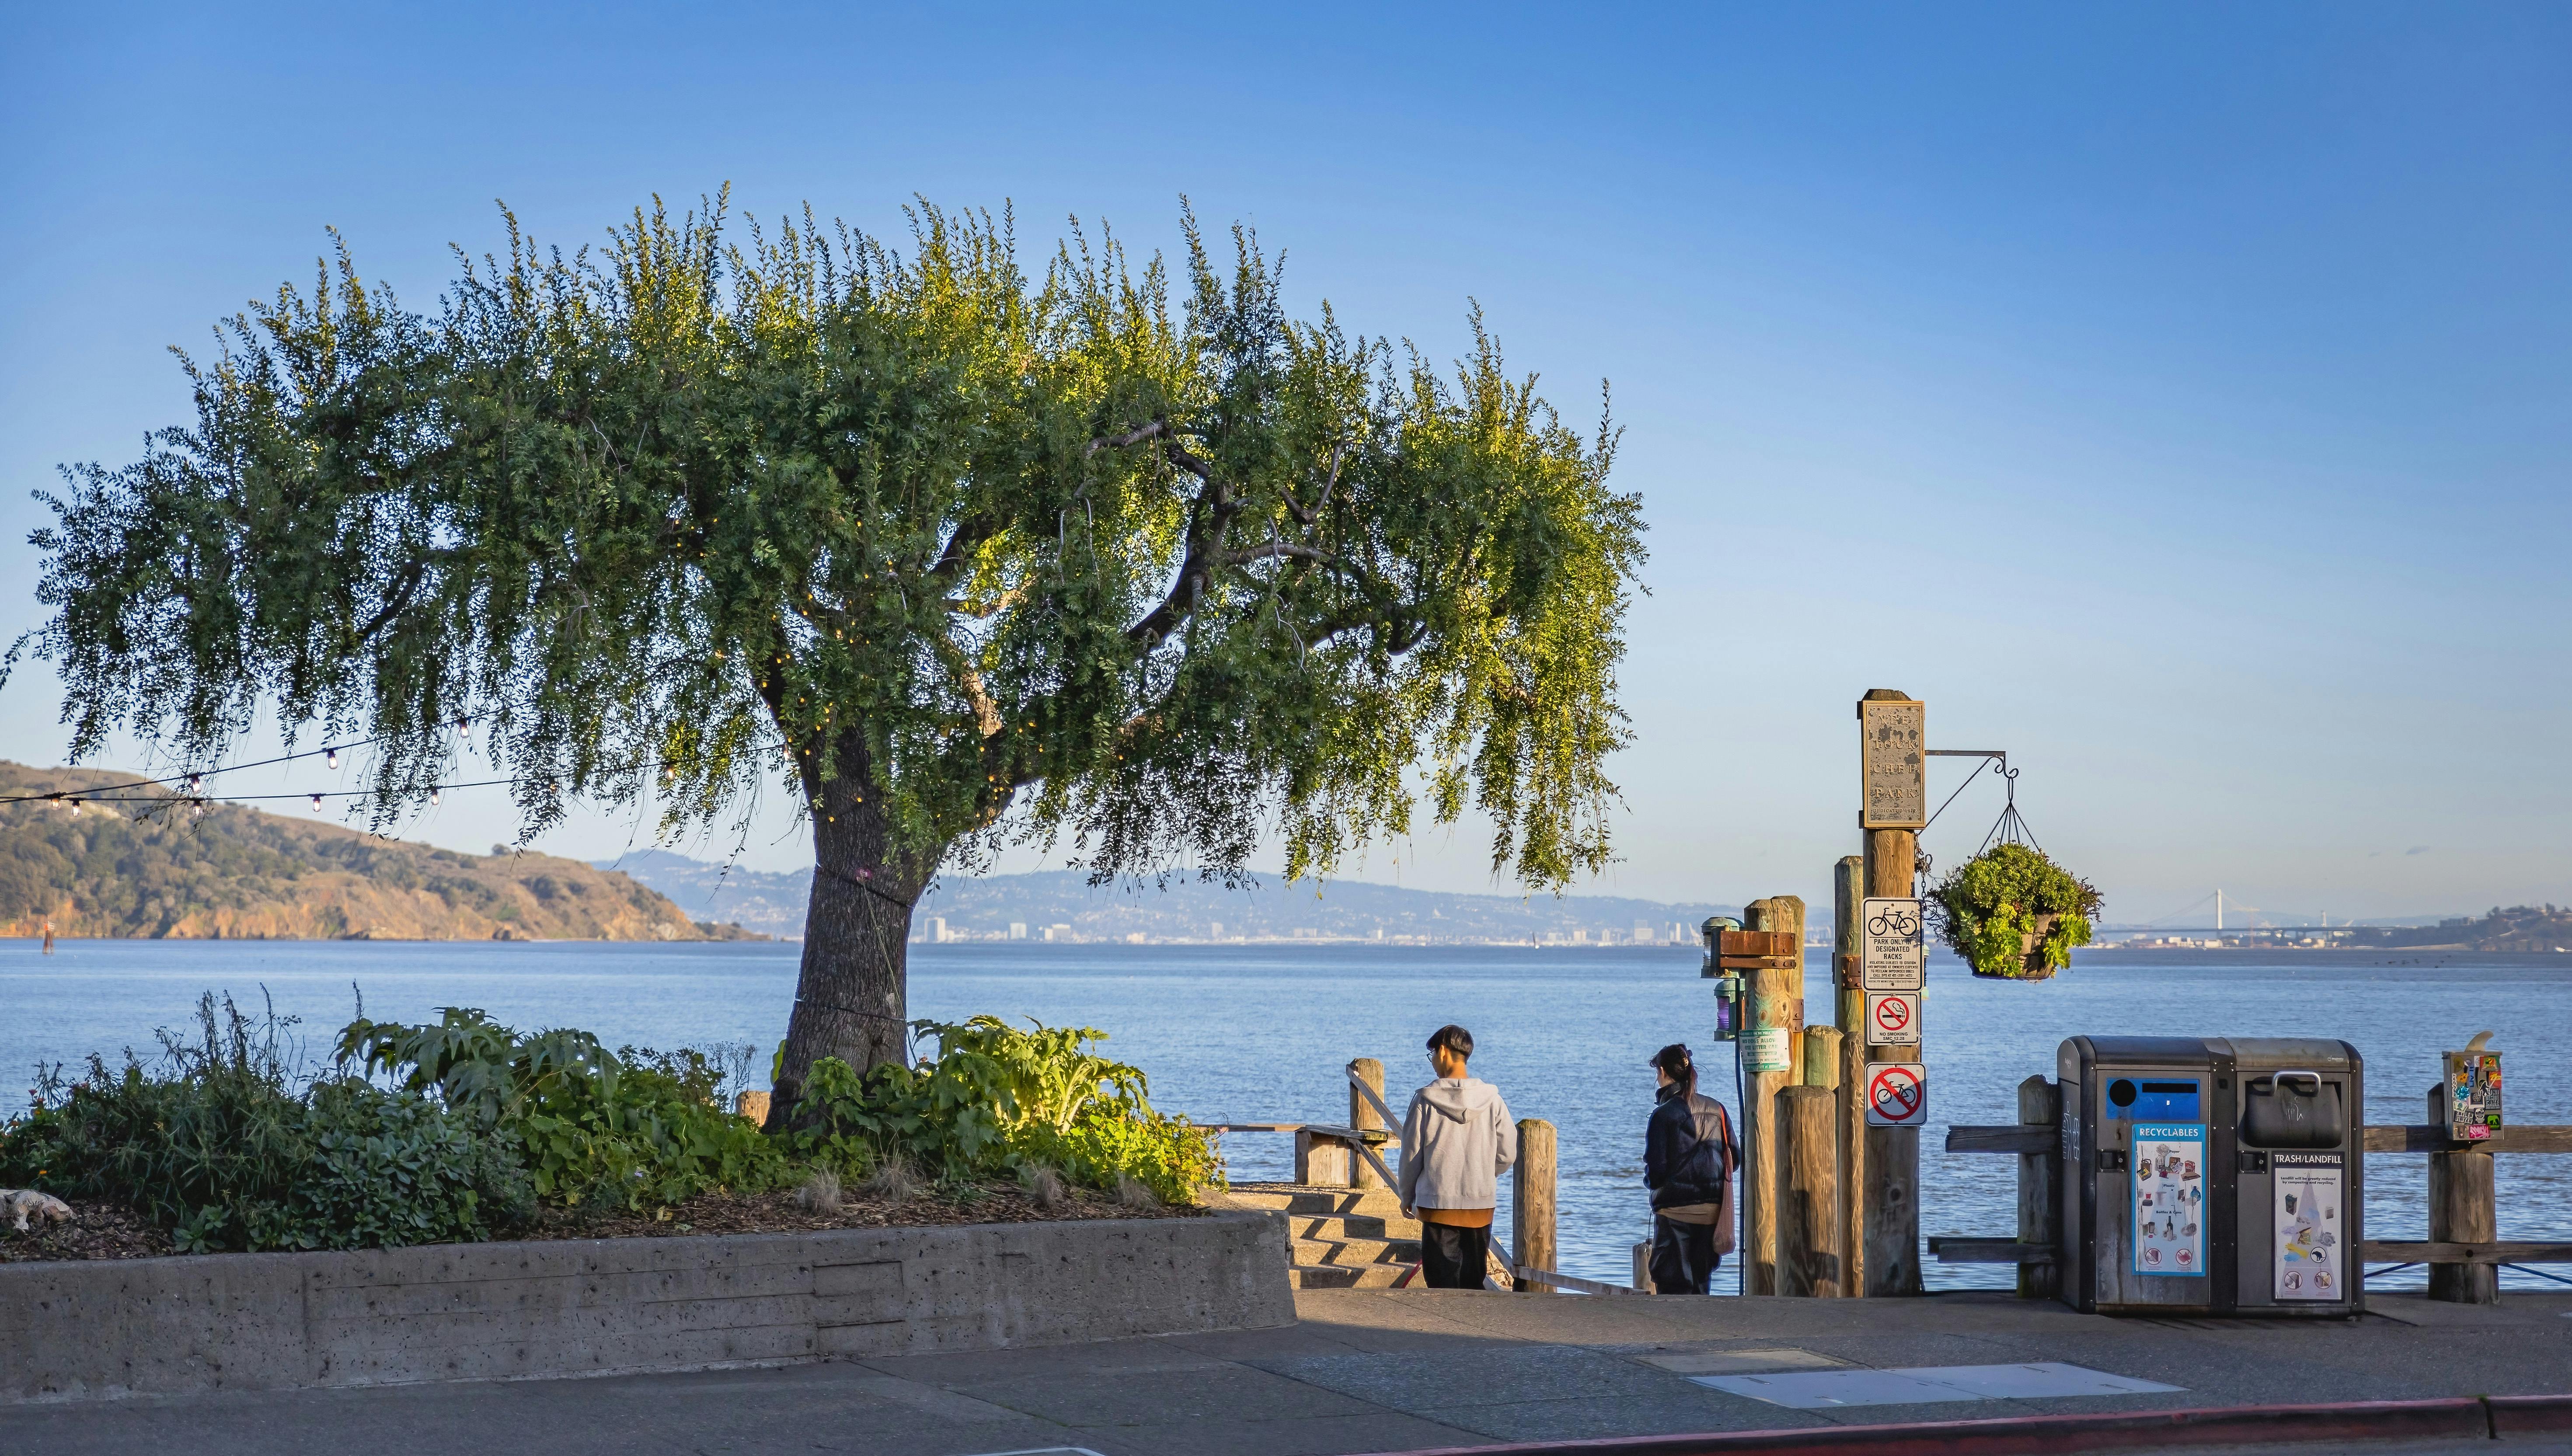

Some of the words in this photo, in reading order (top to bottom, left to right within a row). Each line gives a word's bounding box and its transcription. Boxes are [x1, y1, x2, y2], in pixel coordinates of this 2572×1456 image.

[1873, 739, 1916, 749] TOCK
[1873, 764, 1916, 774] CHEE
[1875, 789, 1916, 798] PARK
[2140, 1128, 2199, 1137] RECYCLABLES
[2275, 1155, 2342, 1163] TRASH/LANDFILL
